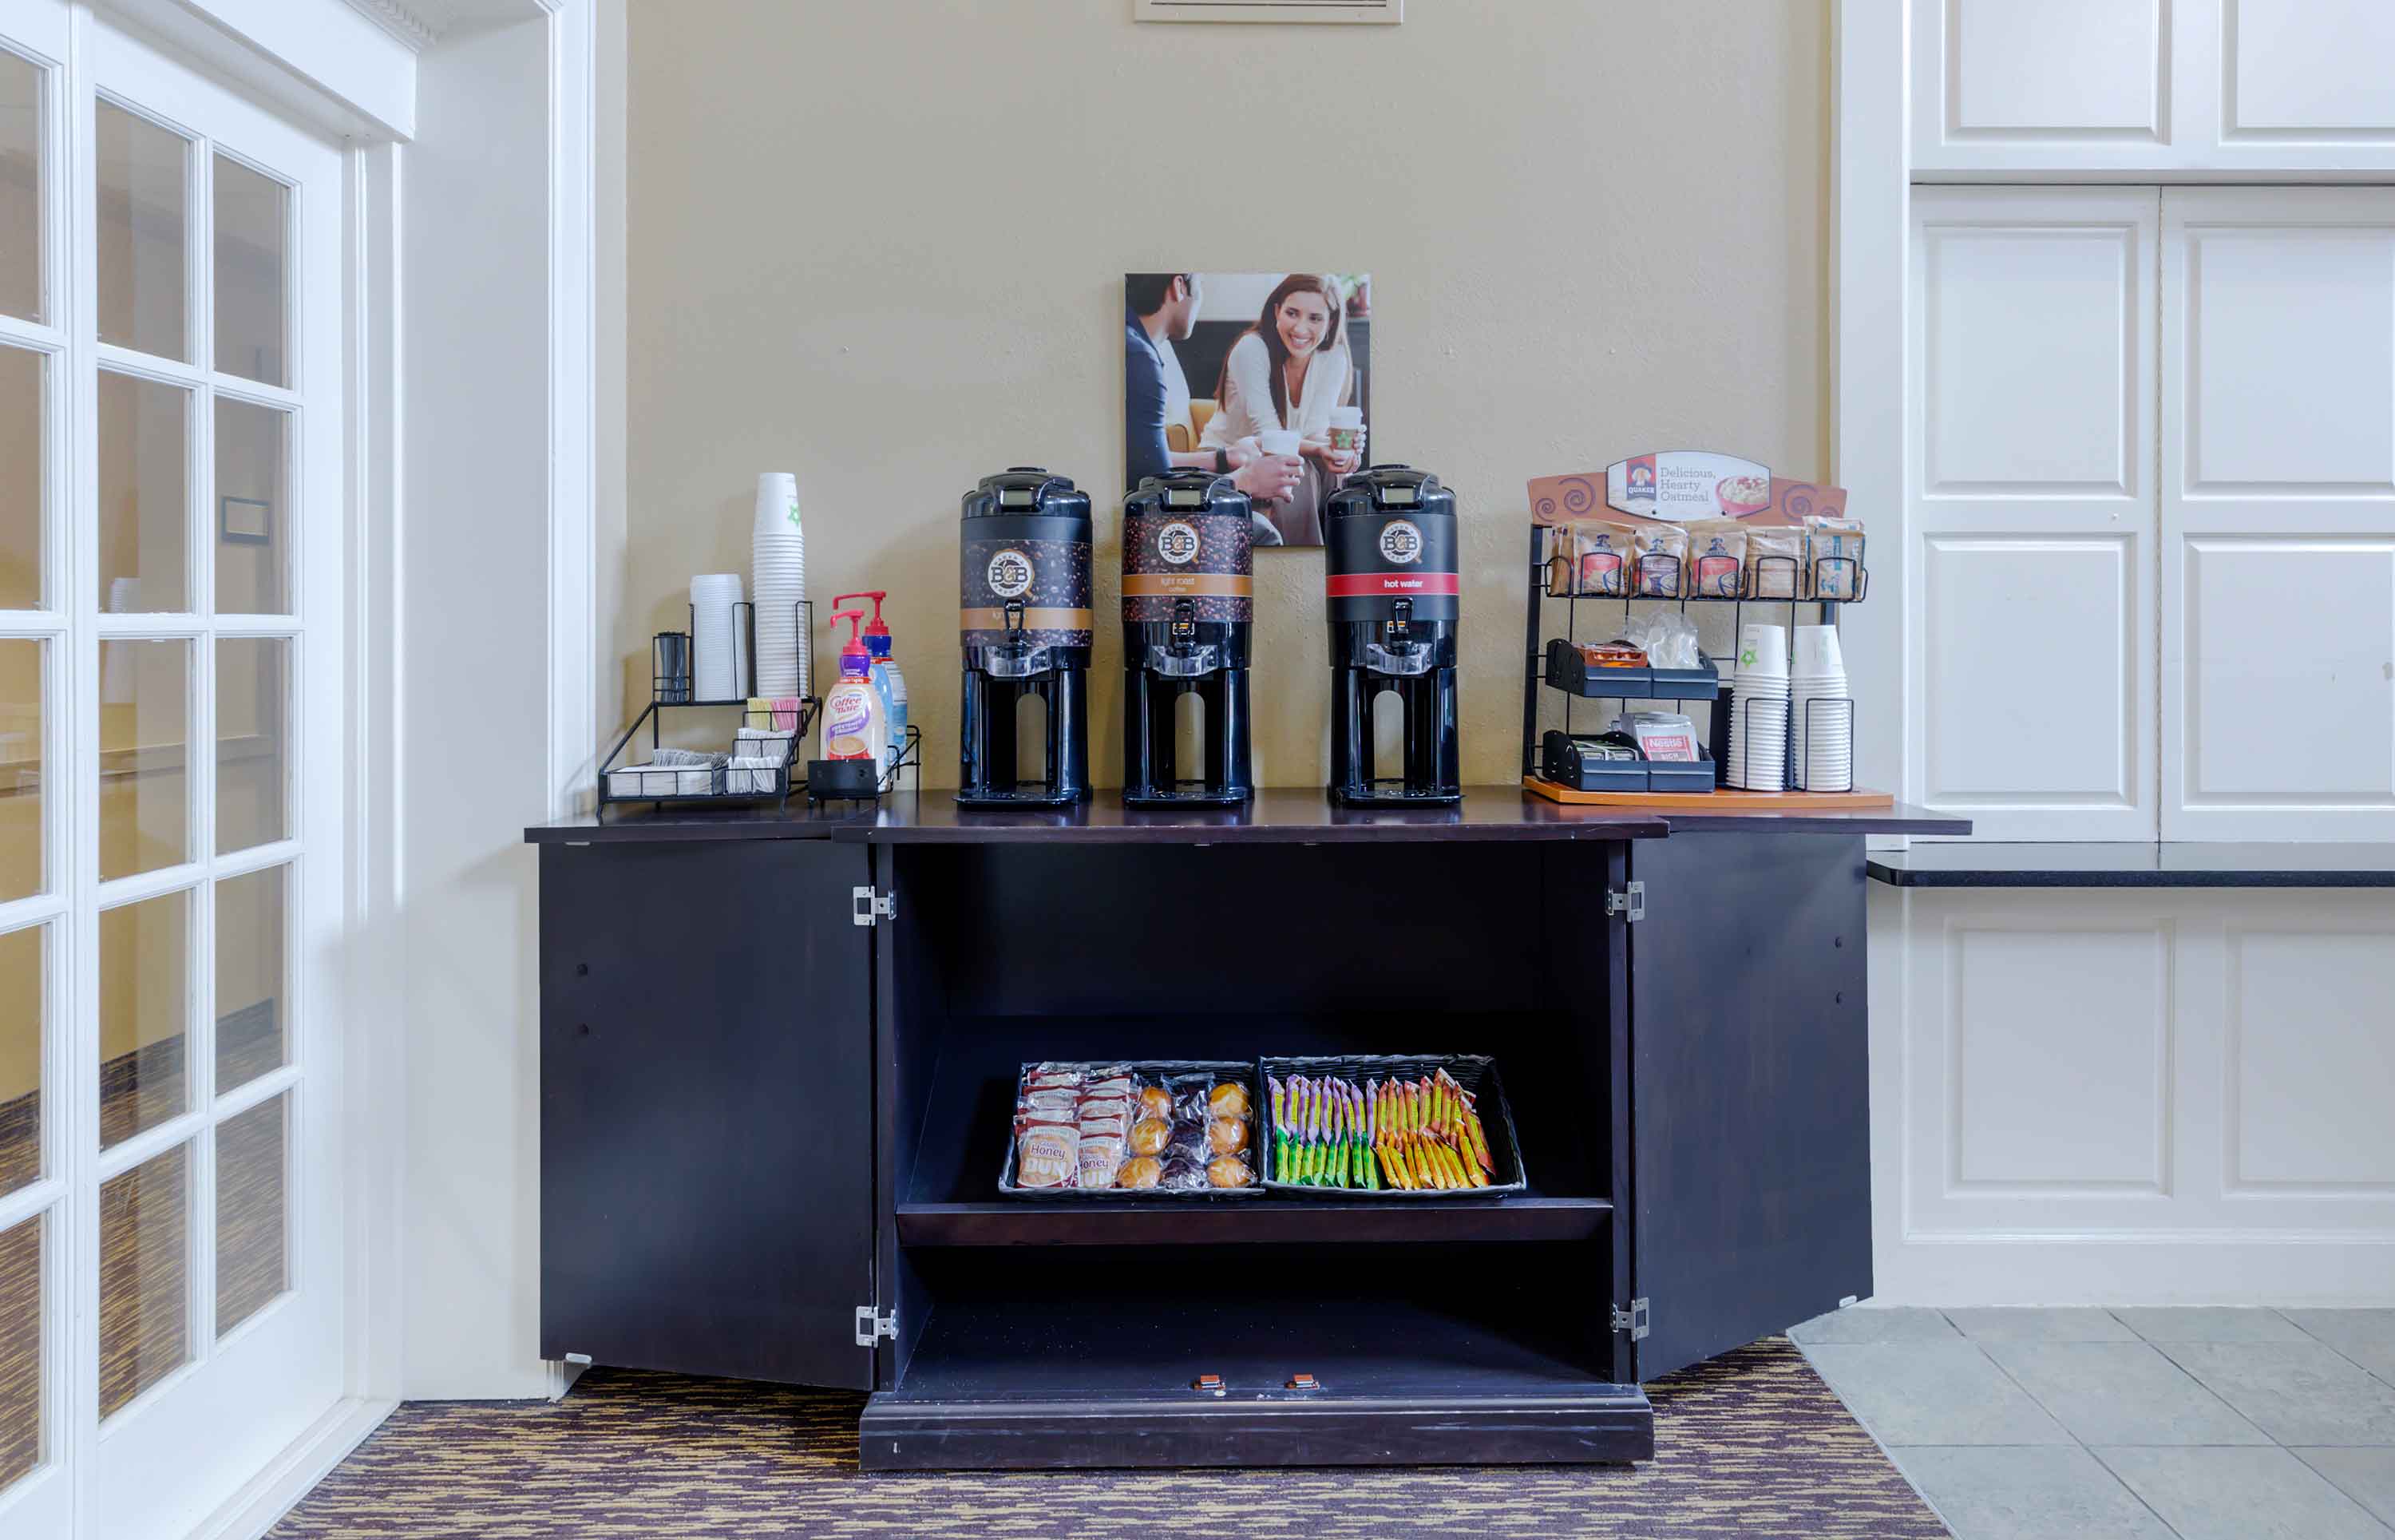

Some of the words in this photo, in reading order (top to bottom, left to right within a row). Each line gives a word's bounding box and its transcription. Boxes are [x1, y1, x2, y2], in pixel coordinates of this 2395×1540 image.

[1660, 466, 1716, 479] Delicious,
[1660, 479, 1701, 492] Hearty
[1660, 491, 1710, 502] Oatmeal
[1160, 536, 1195, 552] B&B
[1383, 536, 1418, 551] B&B
[991, 566, 1028, 584] B&B
[1179, 577, 1195, 586] roast
[1384, 579, 1399, 588] hot
[1400, 579, 1423, 588] water
[830, 695, 862, 710] Coffee
[1031, 1143, 1067, 1161] Honey
[1024, 1158, 1066, 1178] BUN
